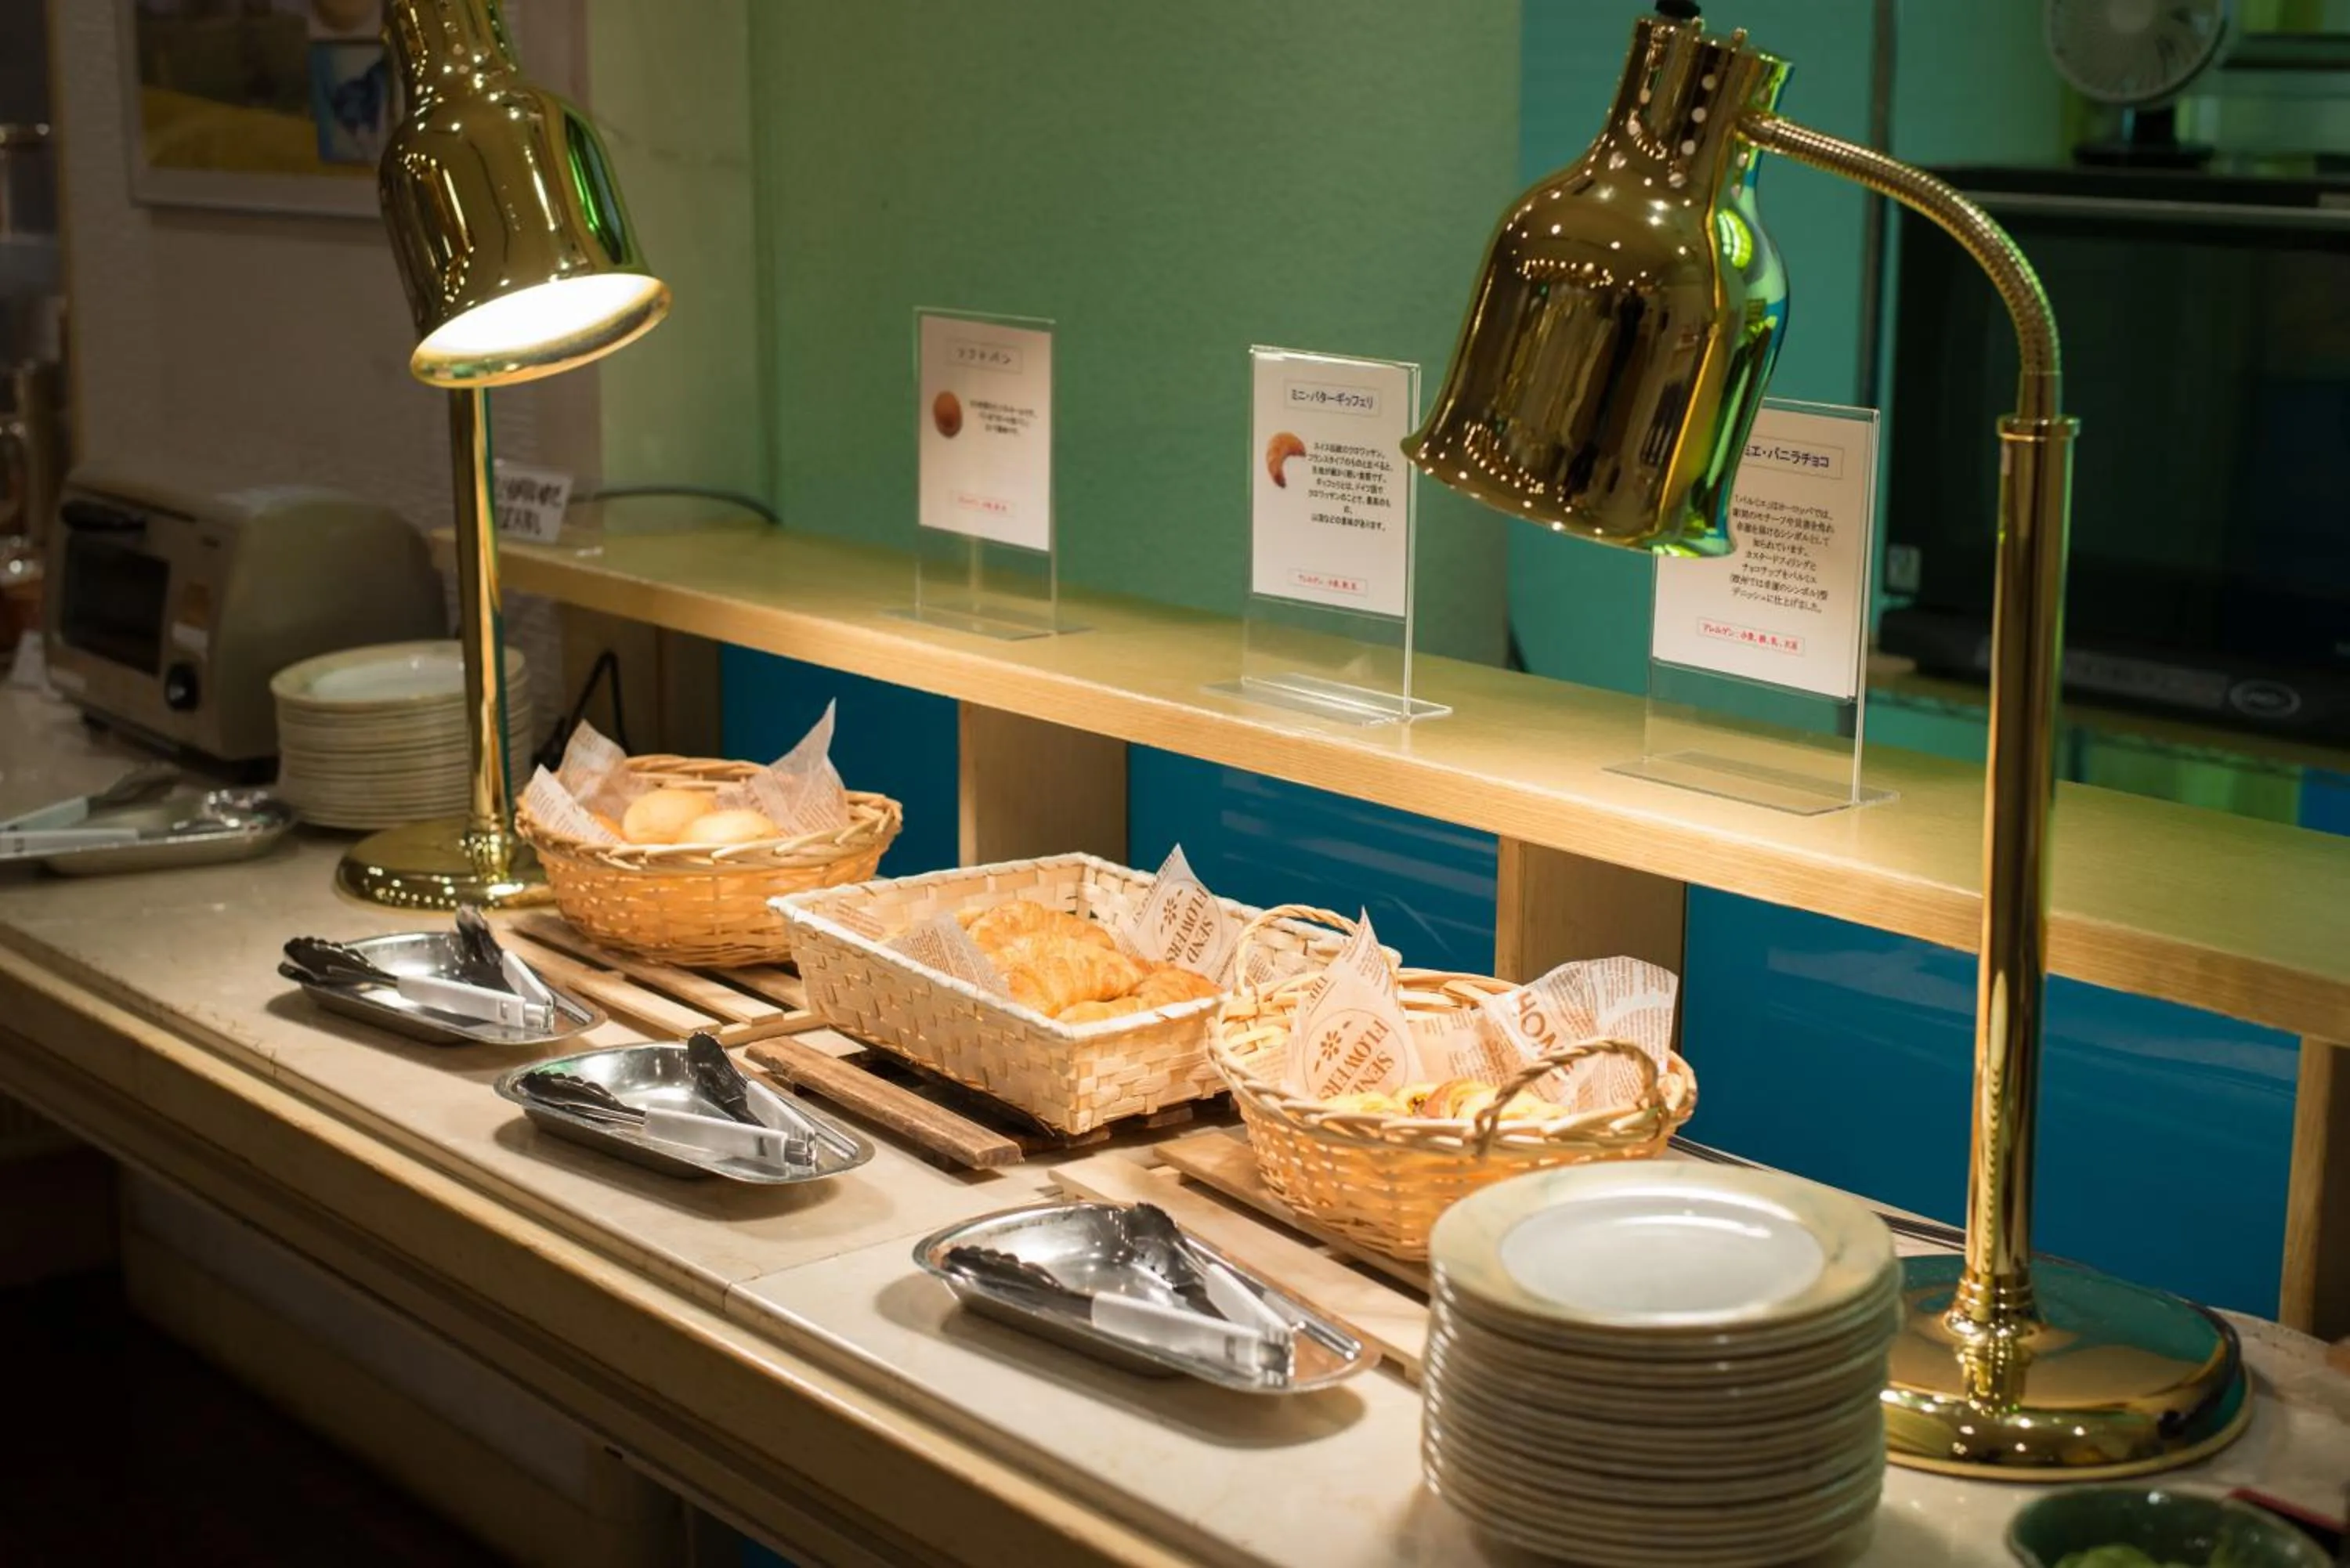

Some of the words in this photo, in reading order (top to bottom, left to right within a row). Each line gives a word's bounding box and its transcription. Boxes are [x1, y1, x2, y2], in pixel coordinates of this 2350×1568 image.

[1166, 887, 1209, 963] FLOWERS
[1186, 916, 1213, 963] SEND
[1318, 1020, 1389, 1100] FLOWERS
